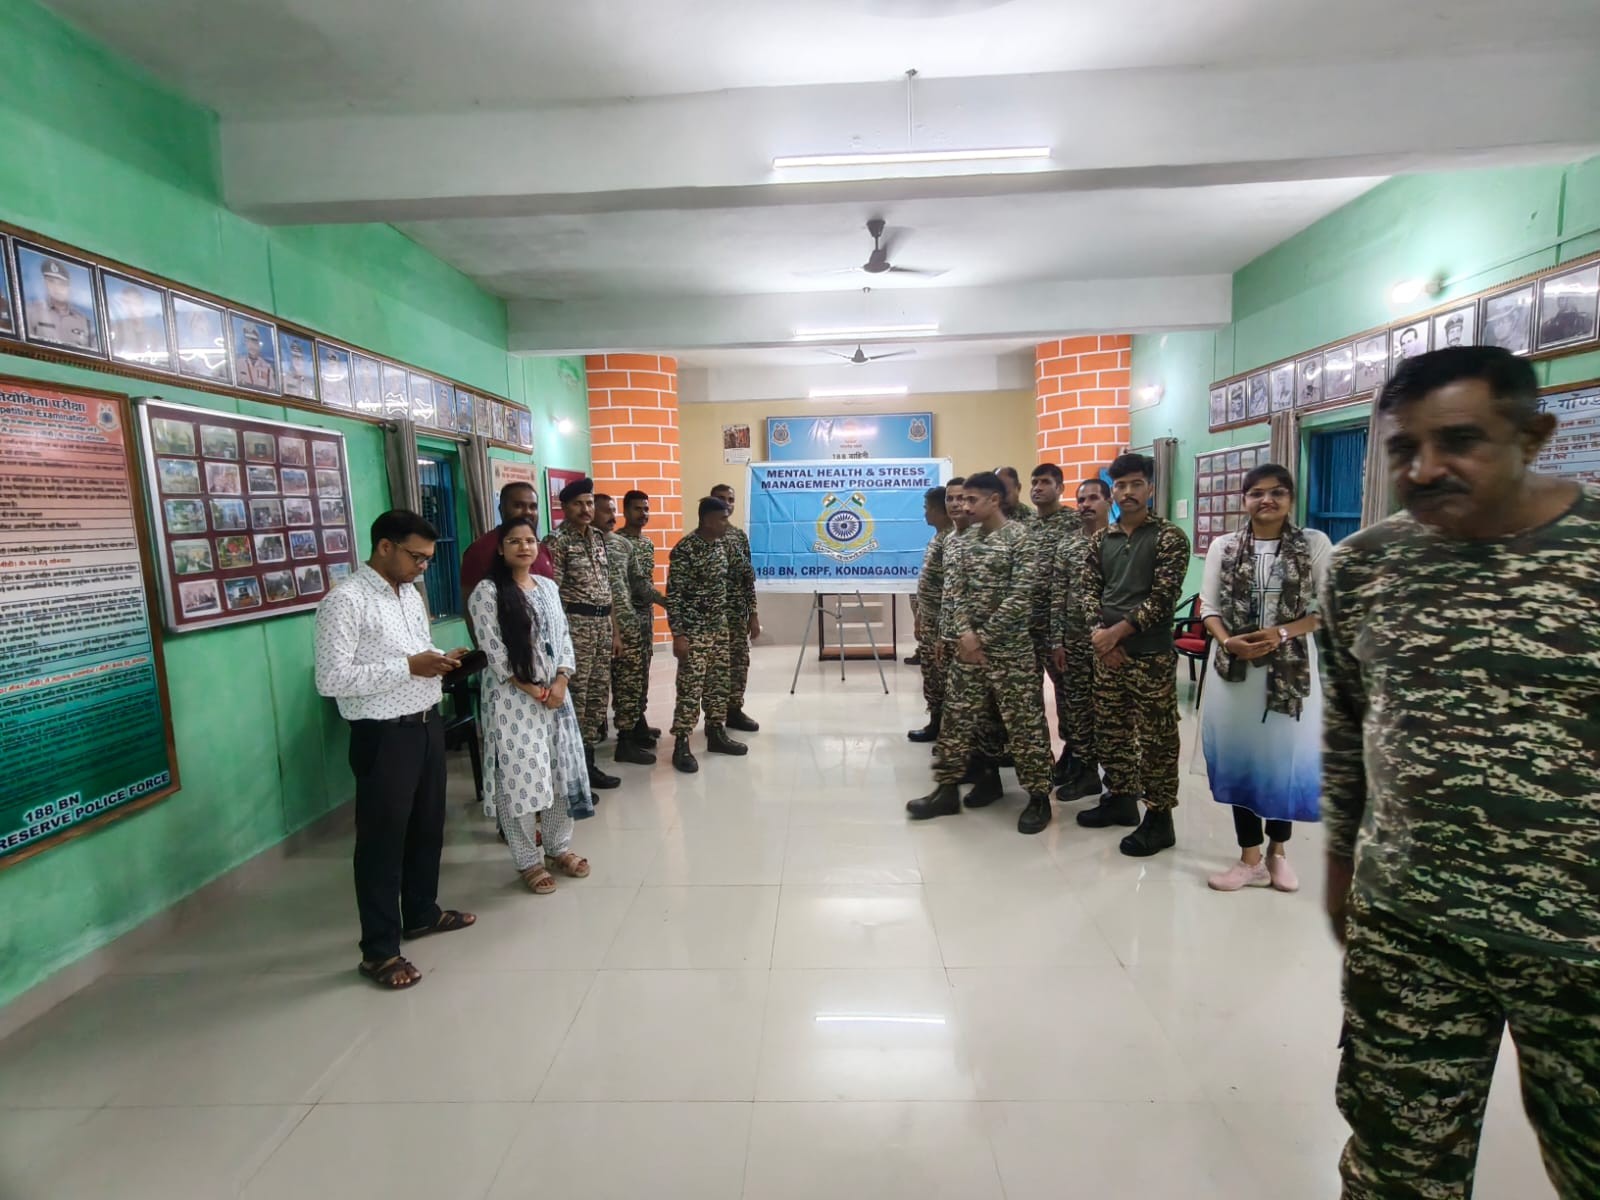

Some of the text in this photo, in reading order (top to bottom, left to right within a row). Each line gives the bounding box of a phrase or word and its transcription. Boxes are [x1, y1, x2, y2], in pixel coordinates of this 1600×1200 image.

[52, 398, 85, 412] परीक्षा
[36, 409, 87, 422] Examination
[767, 467, 925, 479] MENTAL HEALTH & STRESS
[761, 479, 931, 489] MANAGEMENT PROGRAMME
[756, 566, 775, 576] 188
[778, 566, 798, 577] BN,
[801, 566, 832, 577] CRPF,
[0, 772, 169, 850] RESERVE POLICE FORCE
[25, 793, 80, 822] 188 BN
